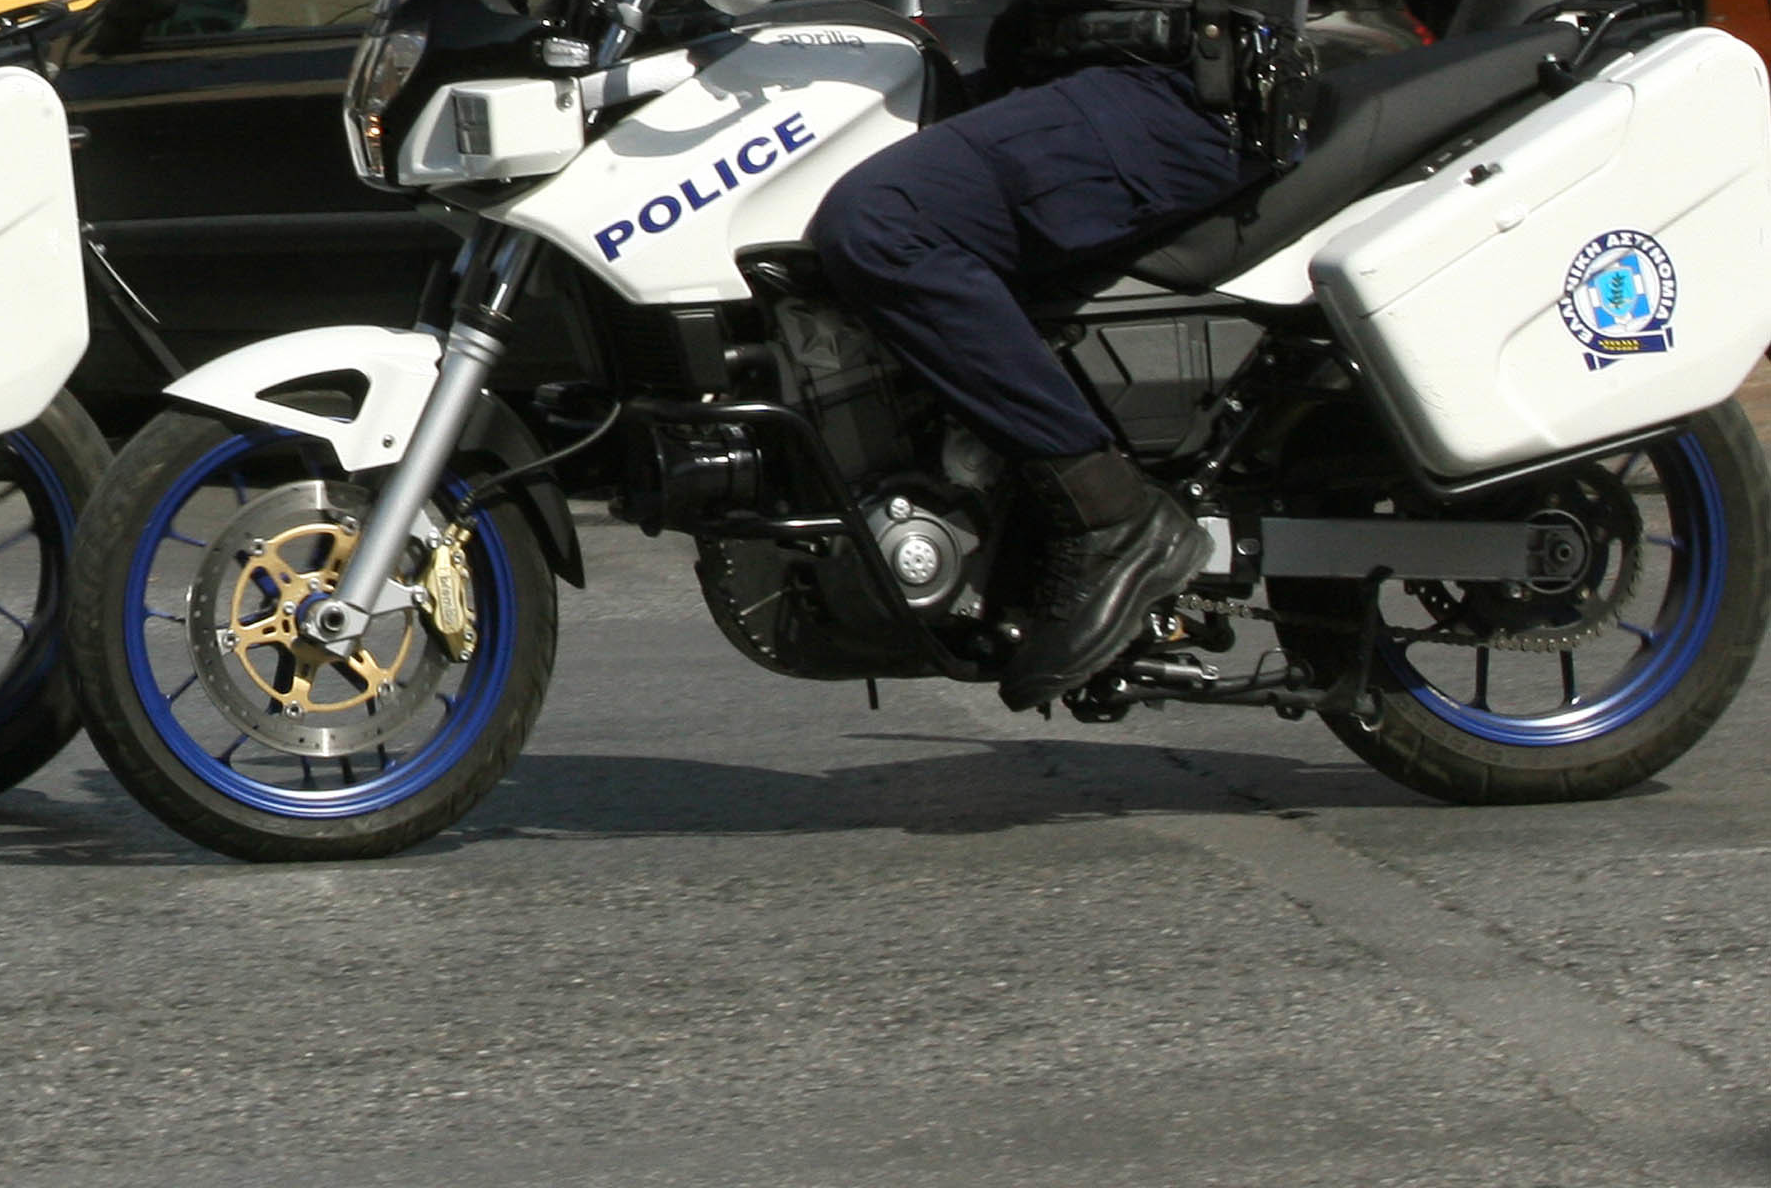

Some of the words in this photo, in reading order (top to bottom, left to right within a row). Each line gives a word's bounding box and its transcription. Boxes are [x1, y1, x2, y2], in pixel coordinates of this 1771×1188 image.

[775, 28, 866, 48] aprilia
[593, 112, 816, 263] POLICE
[1605, 232, 1675, 320] ΑΣΤΥΝΟΜΙΑ
